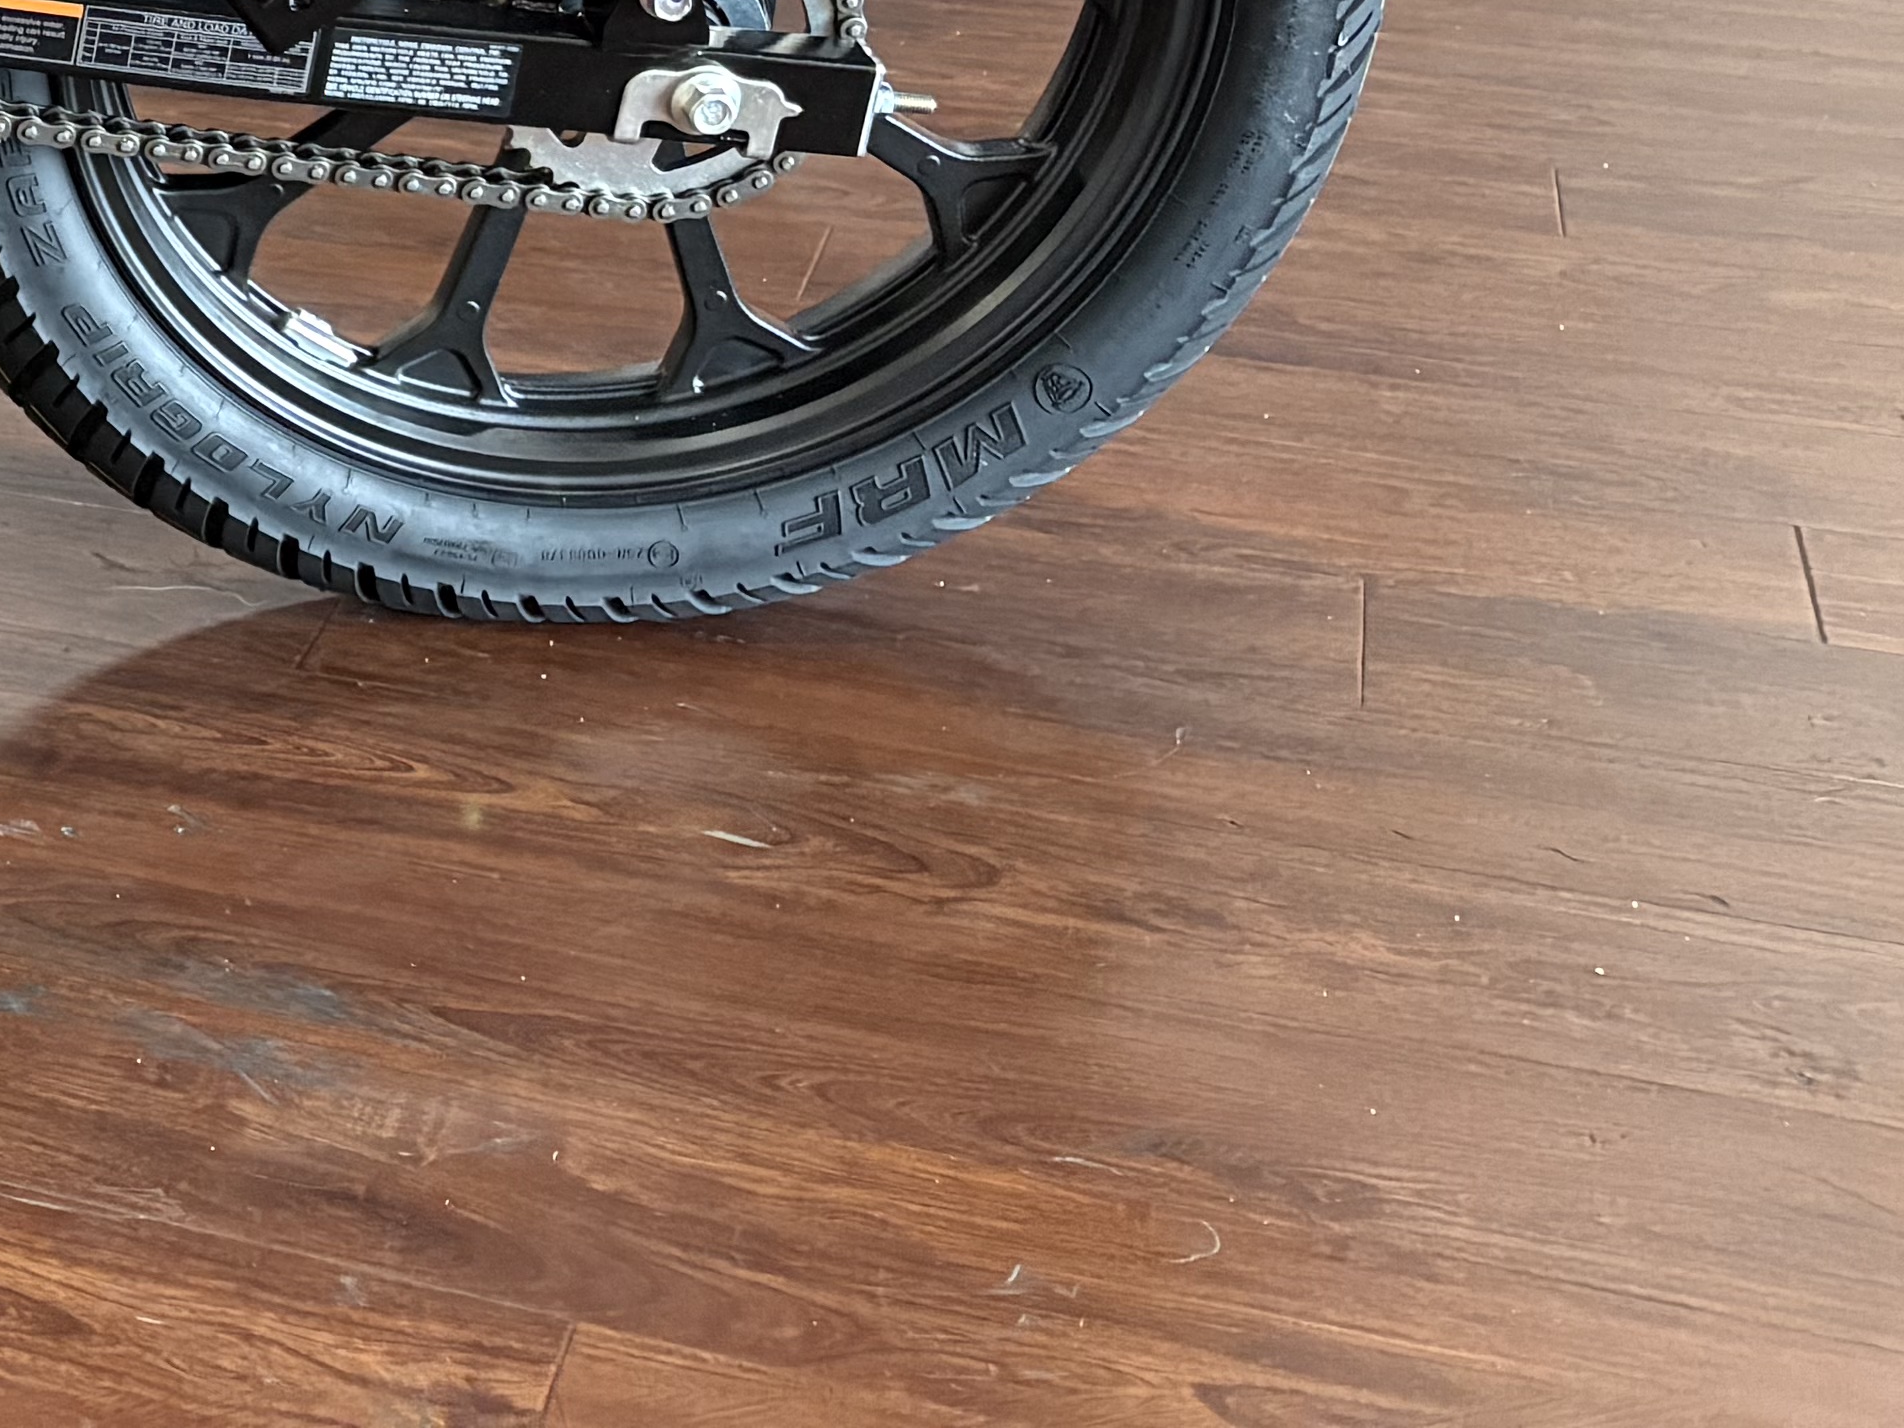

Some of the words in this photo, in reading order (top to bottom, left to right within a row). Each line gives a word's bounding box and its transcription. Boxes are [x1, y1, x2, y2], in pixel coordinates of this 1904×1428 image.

[142, 14, 169, 26] TIRE
[171, 17, 196, 29] AND
[197, 20, 229, 32] LOAD
[60, 302, 405, 546] NYLOGRIP
[778, 400, 1033, 557] MRF
